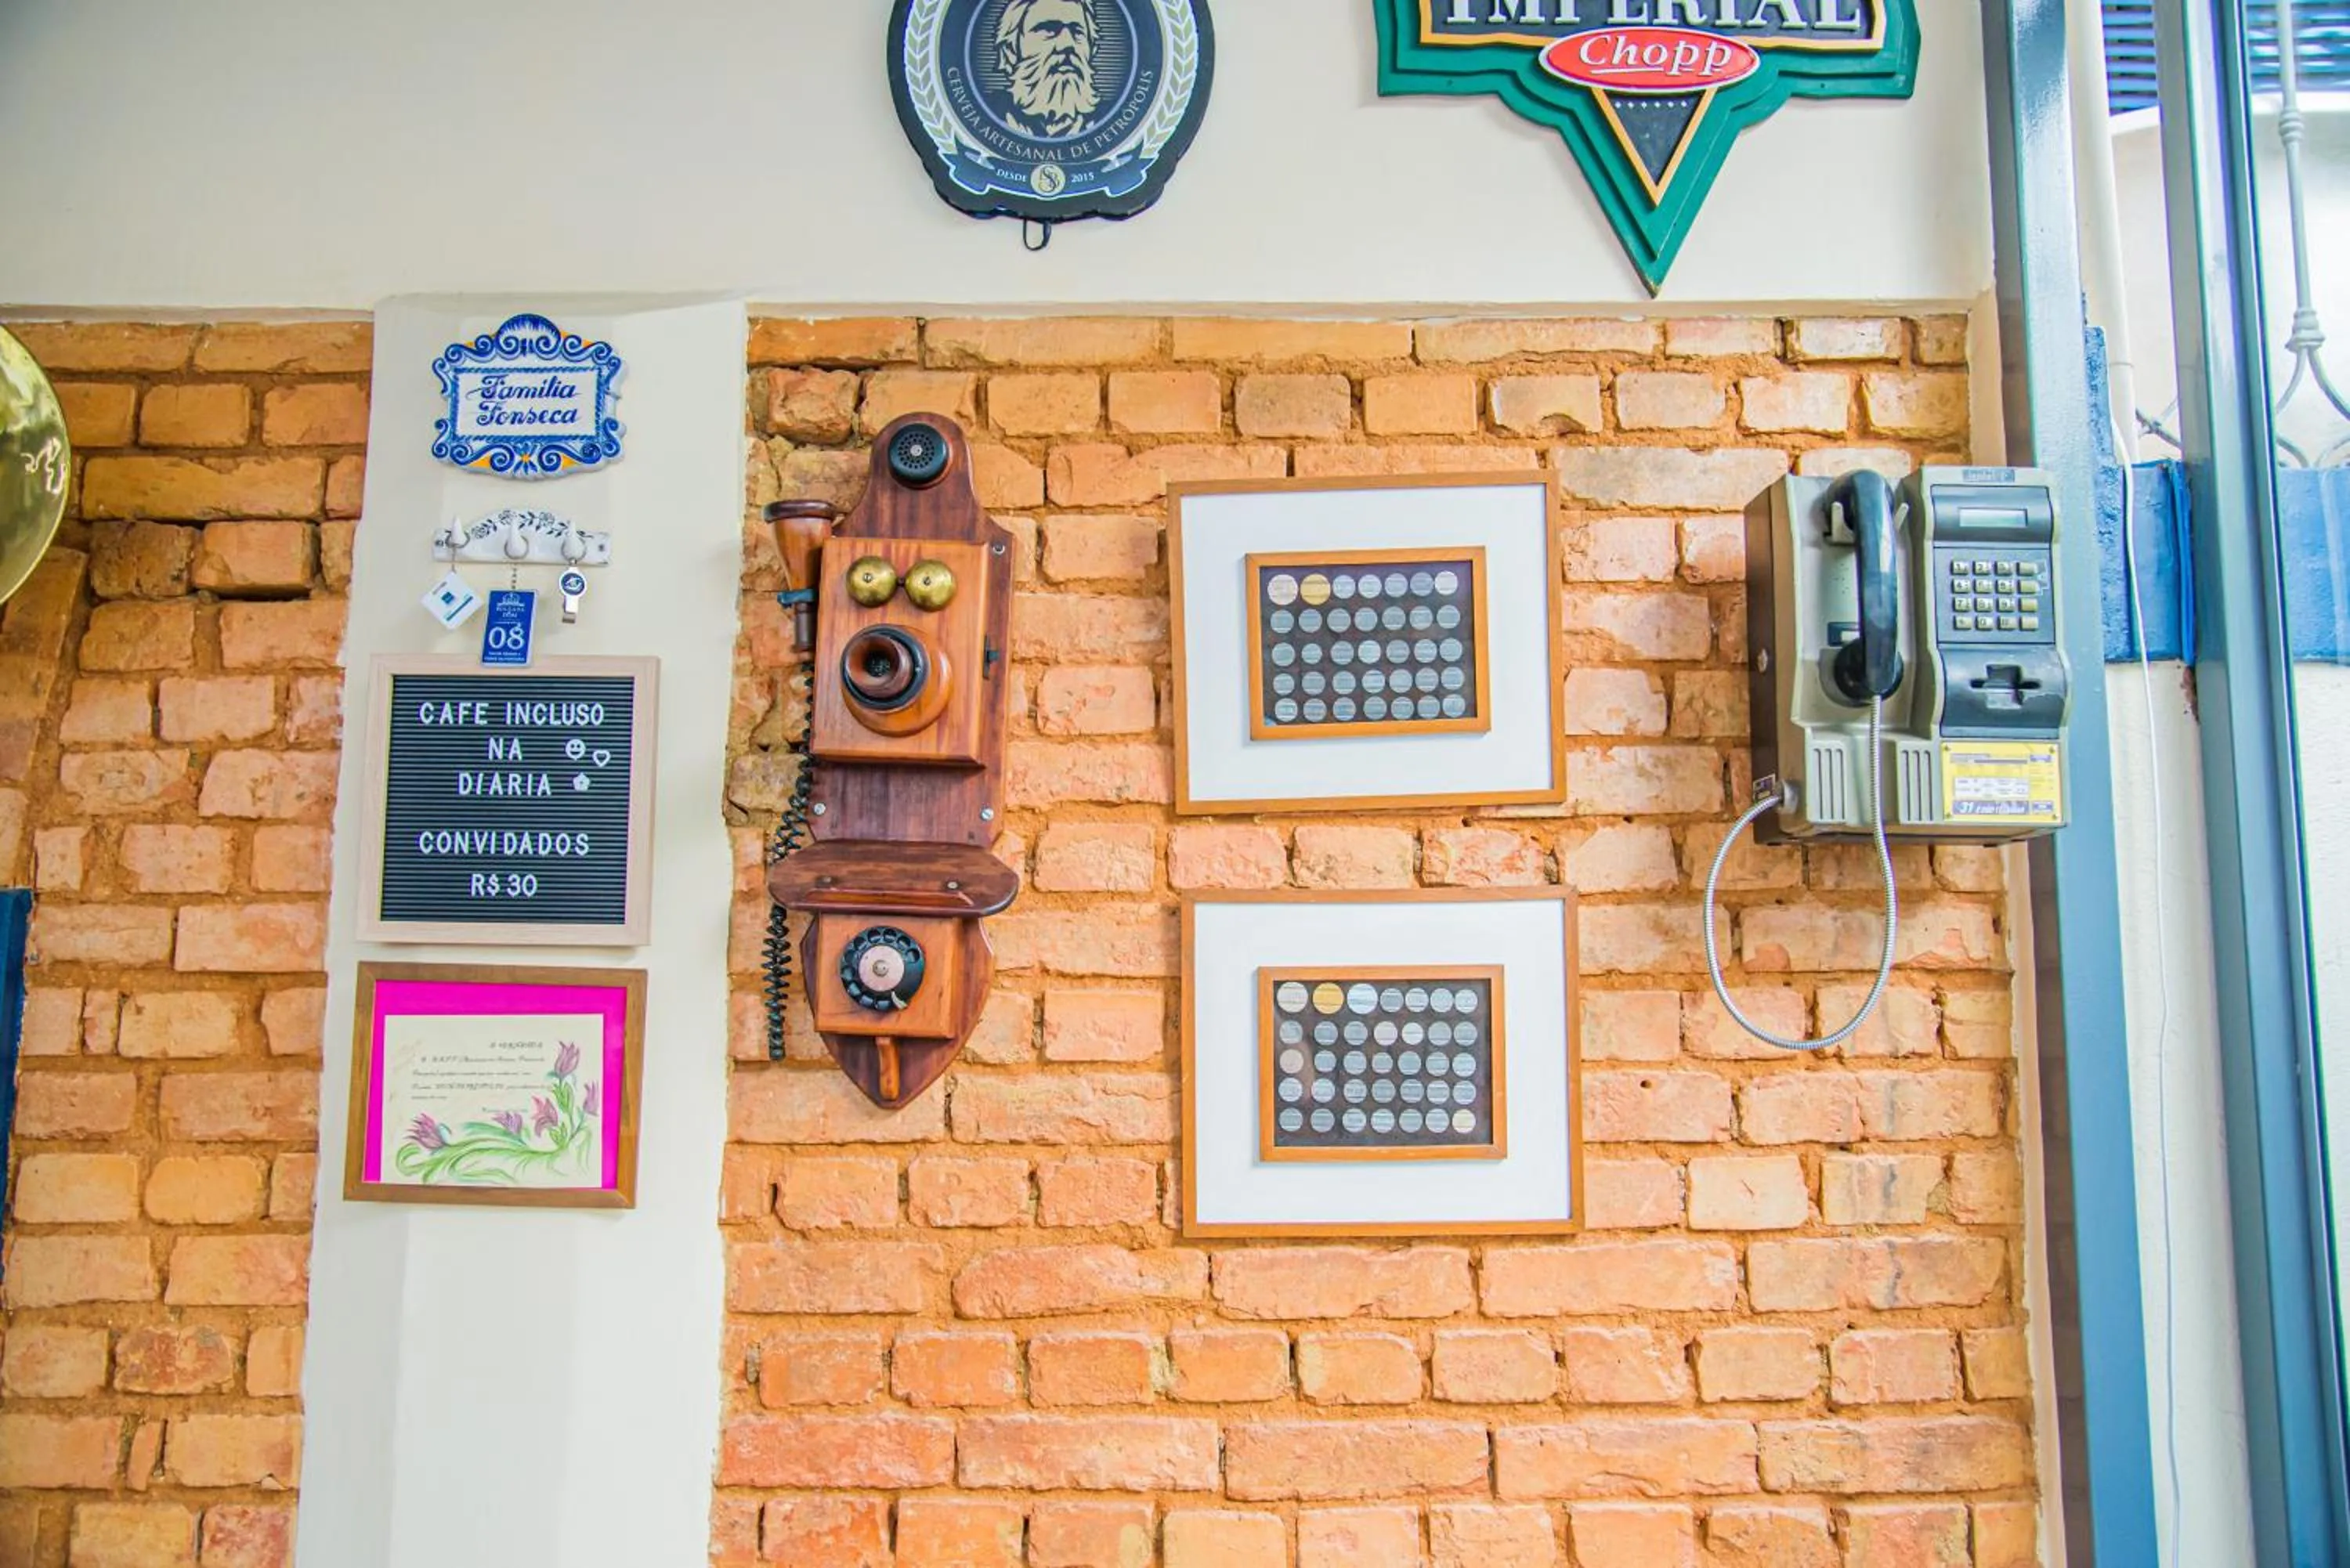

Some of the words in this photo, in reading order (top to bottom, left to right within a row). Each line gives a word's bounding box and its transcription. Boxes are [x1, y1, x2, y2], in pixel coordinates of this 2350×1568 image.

[1580, 34, 1732, 76] Chopp
[947, 67, 981, 126] CERVEJA
[980, 125, 1065, 161] ARTESANAL
[1070, 141, 1092, 158] DE
[996, 168, 1029, 182] DESDE
[1071, 172, 1094, 183] 2015
[475, 400, 580, 427] Fonseca
[488, 626, 526, 650] 08
[418, 701, 490, 726] CAFE
[505, 702, 605, 726] INCLUSO
[487, 736, 523, 761] NA
[457, 772, 552, 797] DIARIA
[418, 830, 590, 856] CONVIDADOS
